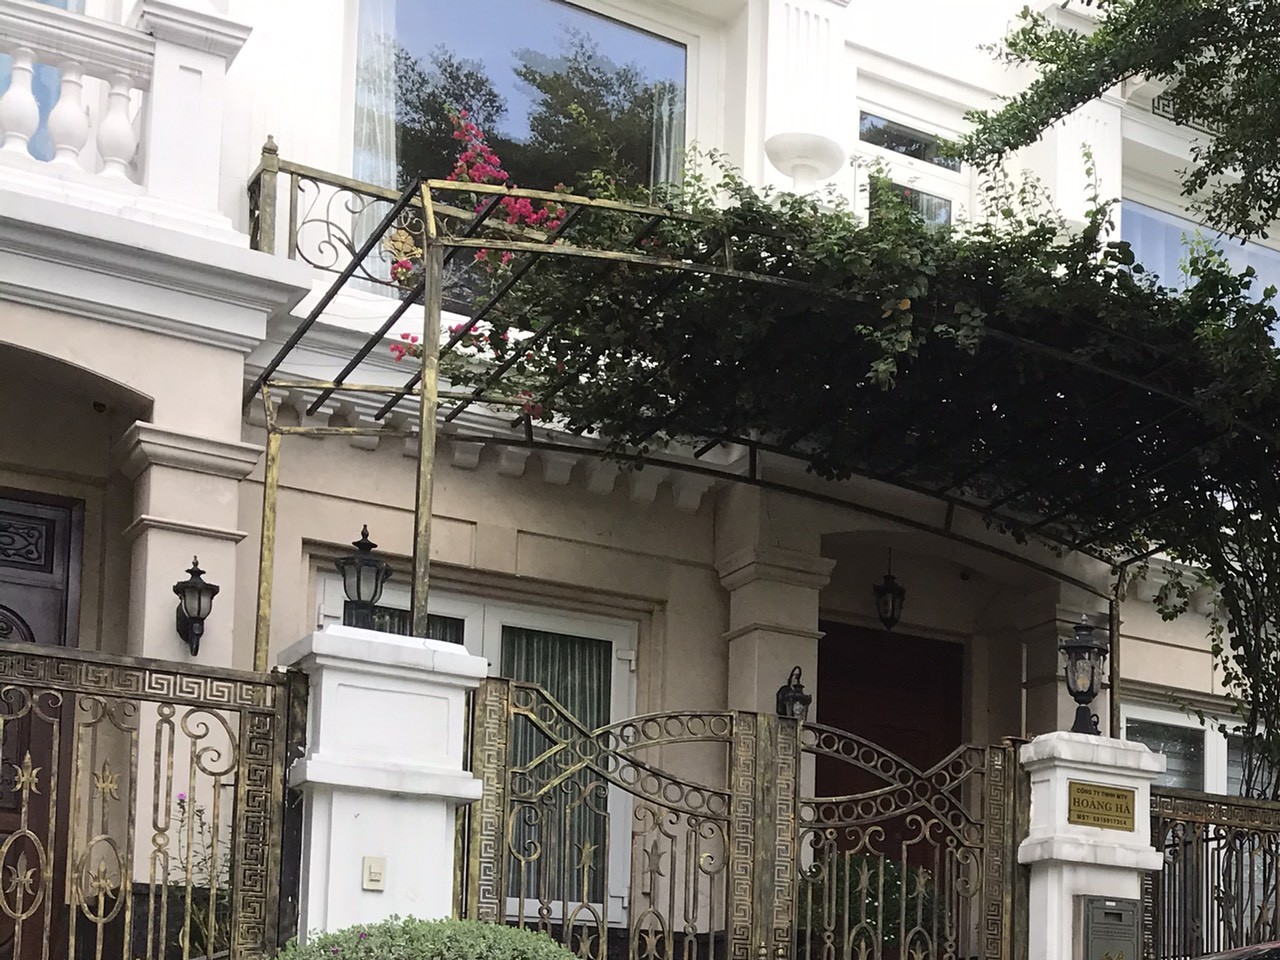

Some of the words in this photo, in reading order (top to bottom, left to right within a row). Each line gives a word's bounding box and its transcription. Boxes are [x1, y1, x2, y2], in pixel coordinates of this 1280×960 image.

[1093, 789, 1100, 797] TY
[1073, 796, 1113, 812] HOÀNG
[1115, 801, 1131, 815] HÀ
